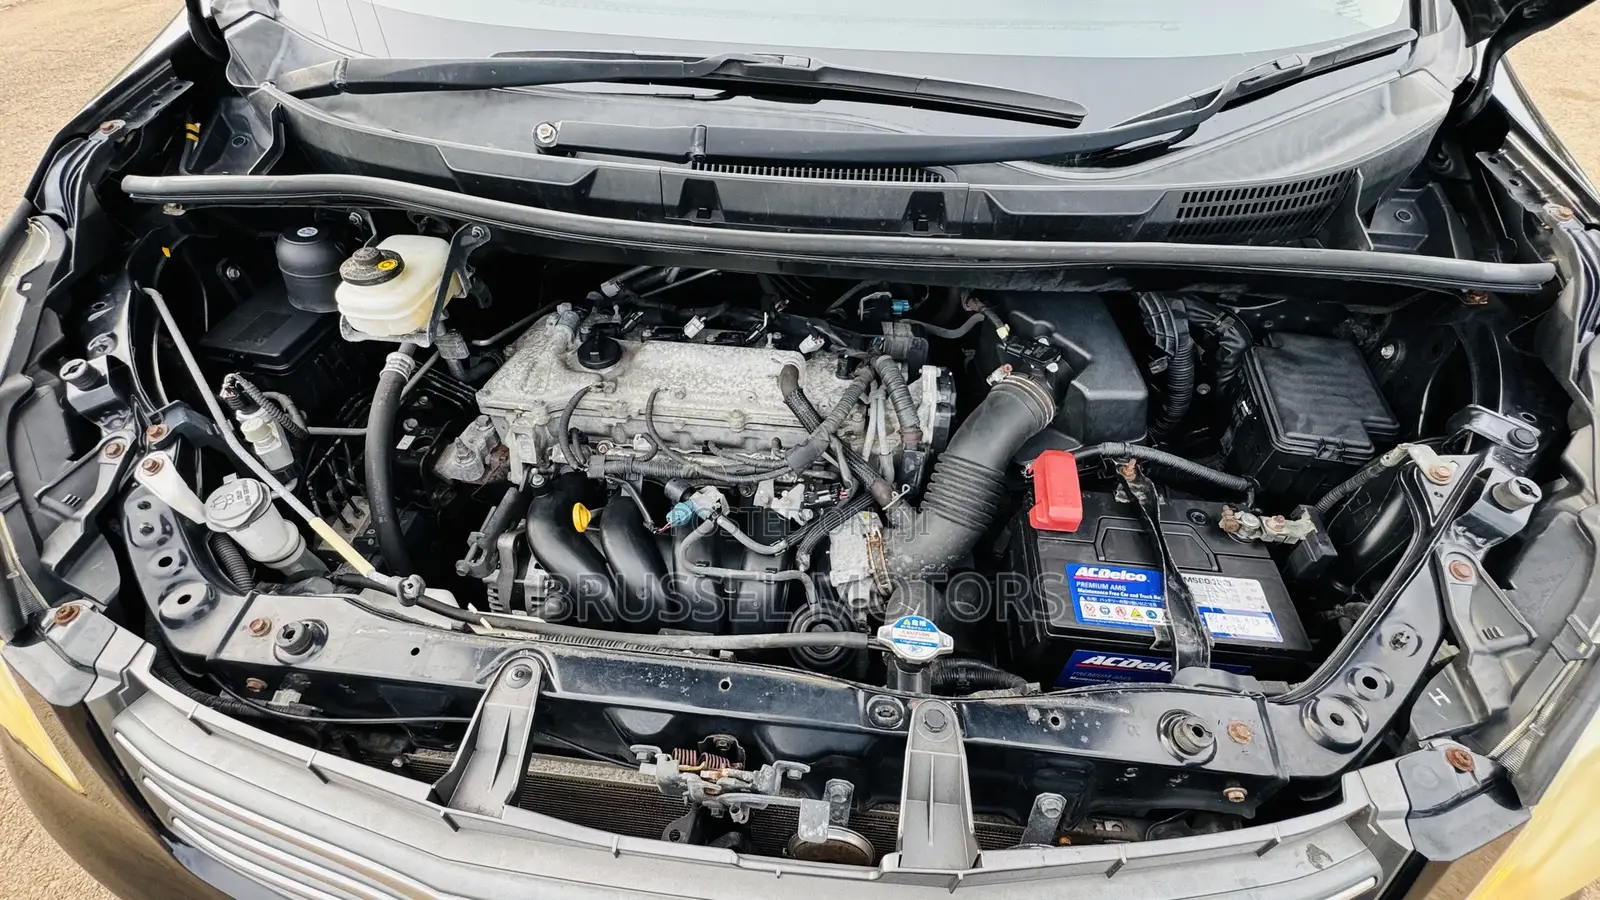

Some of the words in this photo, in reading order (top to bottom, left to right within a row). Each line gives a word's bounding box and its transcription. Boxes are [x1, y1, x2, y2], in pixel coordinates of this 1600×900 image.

[1075, 566, 1147, 582] ACDelco
[1076, 581, 1109, 590] PREMIUM
[1110, 584, 1127, 592] AMS
[1081, 655, 1172, 672] ACDelc
